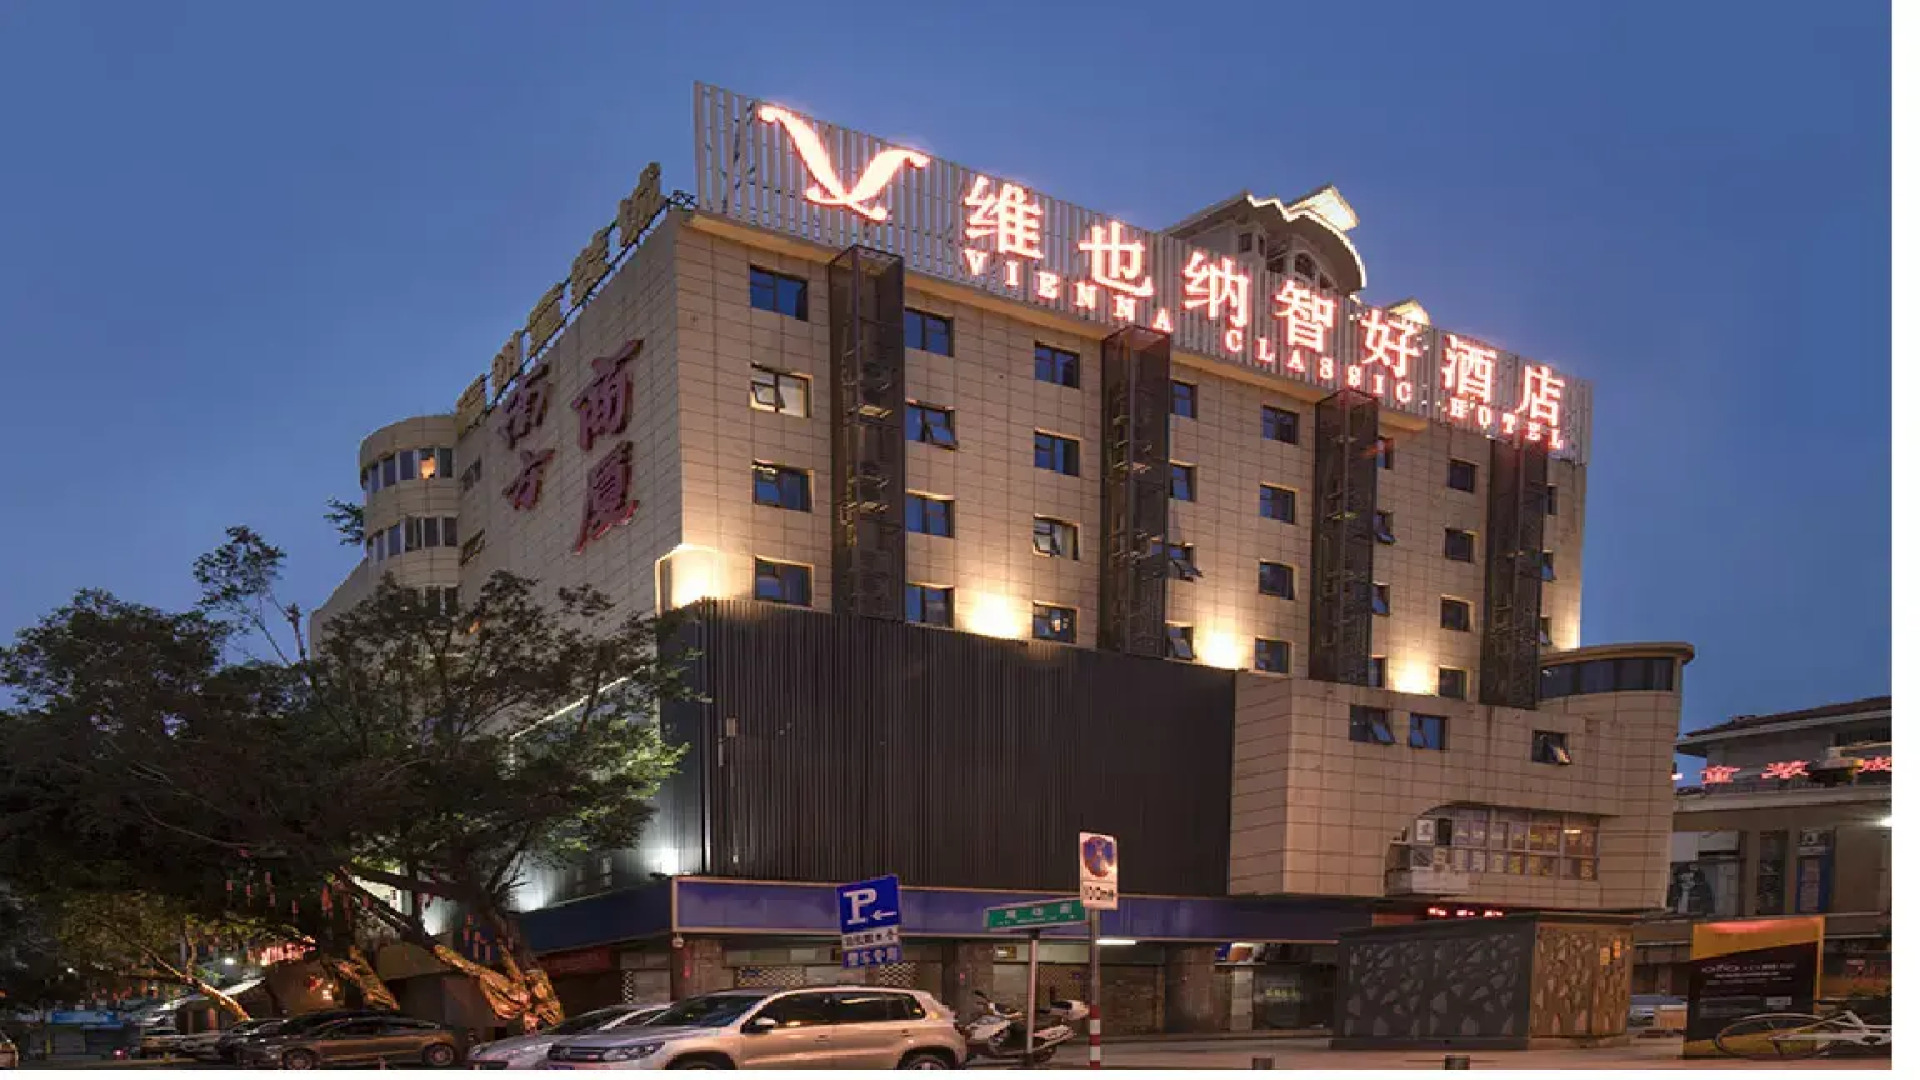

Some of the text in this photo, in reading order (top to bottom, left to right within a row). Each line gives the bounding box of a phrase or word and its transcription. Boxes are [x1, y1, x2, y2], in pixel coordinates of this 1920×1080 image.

[964, 174, 1566, 428] 维也纳智好酒店
[964, 248, 1565, 451] VIENNA CLASSIC HOTEL
[843, 888, 877, 925] P
